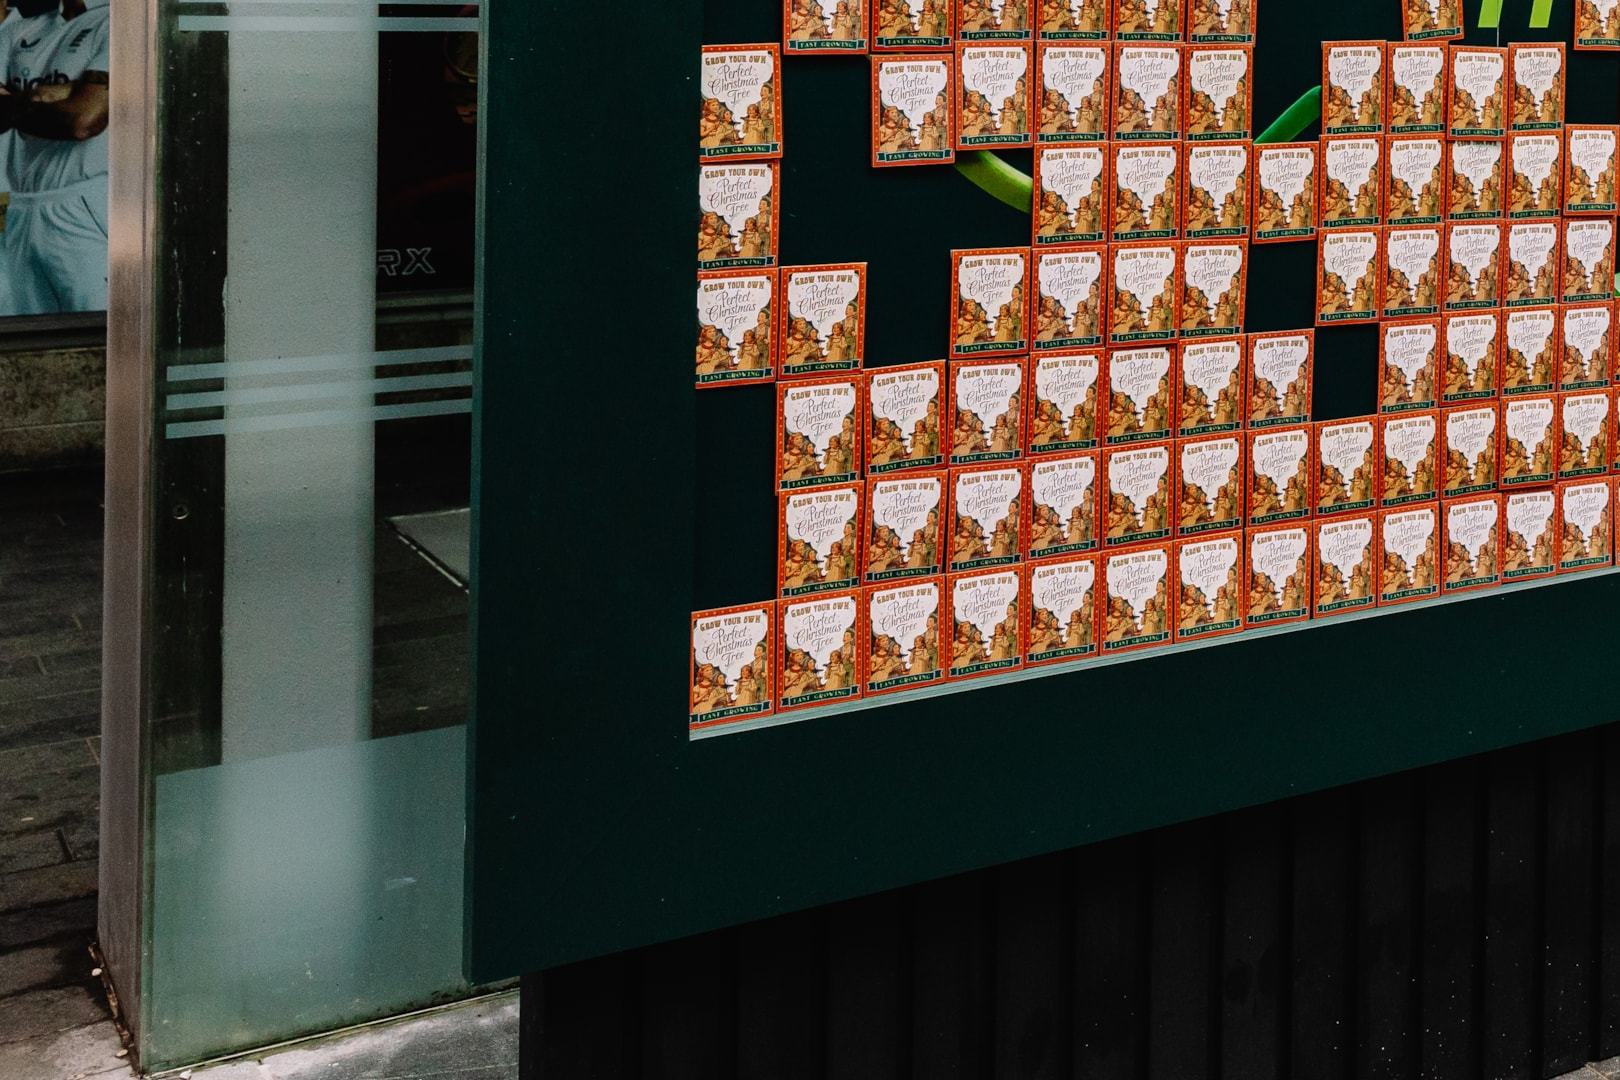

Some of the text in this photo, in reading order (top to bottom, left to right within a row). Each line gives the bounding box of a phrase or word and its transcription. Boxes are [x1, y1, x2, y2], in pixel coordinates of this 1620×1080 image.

[885, 66, 904, 75] GROW
[925, 65, 941, 73] OWN
[1466, 62, 1490, 76] Perfect
[896, 73, 928, 90] Perfect
[1460, 73, 1494, 87] Christmas
[887, 85, 934, 103] Christmas
[1472, 84, 1488, 94] Tree
[905, 98, 926, 111] Tree
[1328, 237, 1343, 245] GROW
[1337, 243, 1362, 258] Perfect
[1329, 254, 1366, 270] Christmas
[1343, 265, 1359, 276] Tree
[794, 276, 815, 286] GROW
[817, 275, 834, 283] YOUR
[806, 283, 839, 301] Perfect
[796, 296, 845, 314] Christmas
[814, 308, 836, 322] Tree
[1037, 564, 1089, 579] GROW YOUR OWN
[1047, 574, 1077, 591] Perfect
[1039, 585, 1082, 605] Christmas
[791, 601, 850, 617] GROW YOUR OWN
[1055, 598, 1074, 611] Tree
[802, 612, 836, 631] Perfect
[793, 624, 842, 645] Christmas
[811, 637, 833, 651] Tree
